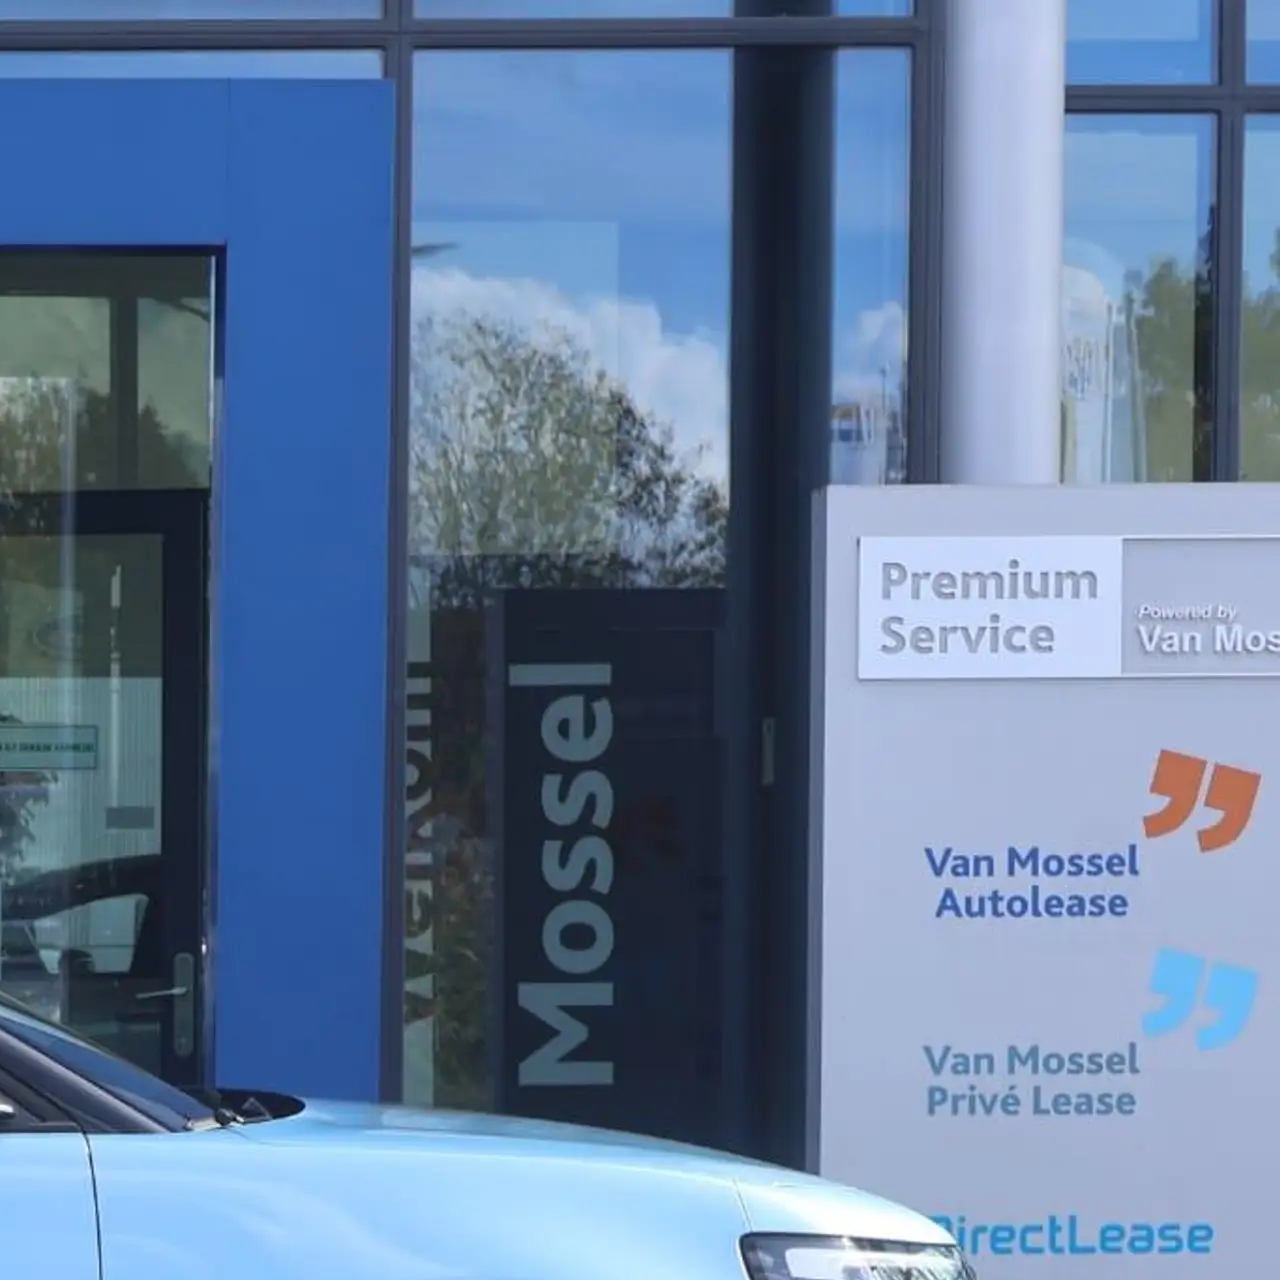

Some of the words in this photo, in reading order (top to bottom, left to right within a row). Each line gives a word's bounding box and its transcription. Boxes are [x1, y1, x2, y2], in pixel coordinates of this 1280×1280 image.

[880, 557, 1099, 602] Premium
[1138, 603, 1213, 620] Powered
[1217, 603, 1238, 623] by
[878, 612, 1056, 656] Service
[1138, 623, 1203, 653] Van
[508, 662, 615, 1087] Mossel
[923, 847, 995, 878] Van
[1007, 843, 1140, 878] Mossel
[935, 884, 1129, 920] Autolease
[922, 1044, 995, 1077] Van
[1007, 1041, 1141, 1077] Mossel
[927, 1084, 1022, 1117] Privé
[1032, 1084, 1138, 1117] Lease
